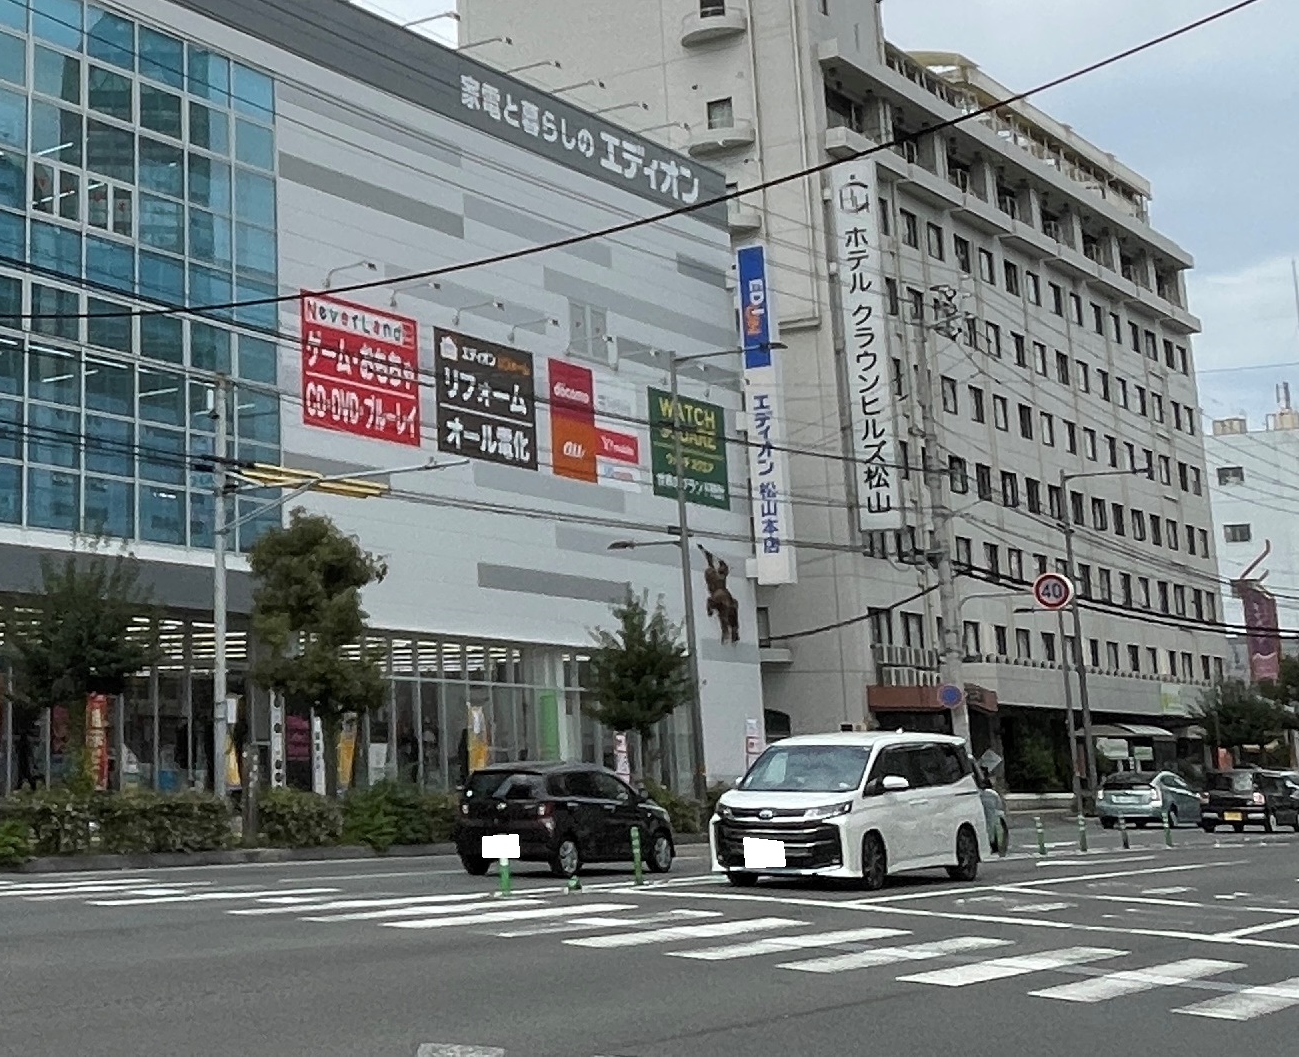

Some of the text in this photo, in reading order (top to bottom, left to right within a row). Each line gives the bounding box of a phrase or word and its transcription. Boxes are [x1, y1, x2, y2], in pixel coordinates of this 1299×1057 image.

[600, 131, 699, 204] エディオン
[444, 366, 527, 416] リフォーム
[1041, 582, 1063, 599] 40
